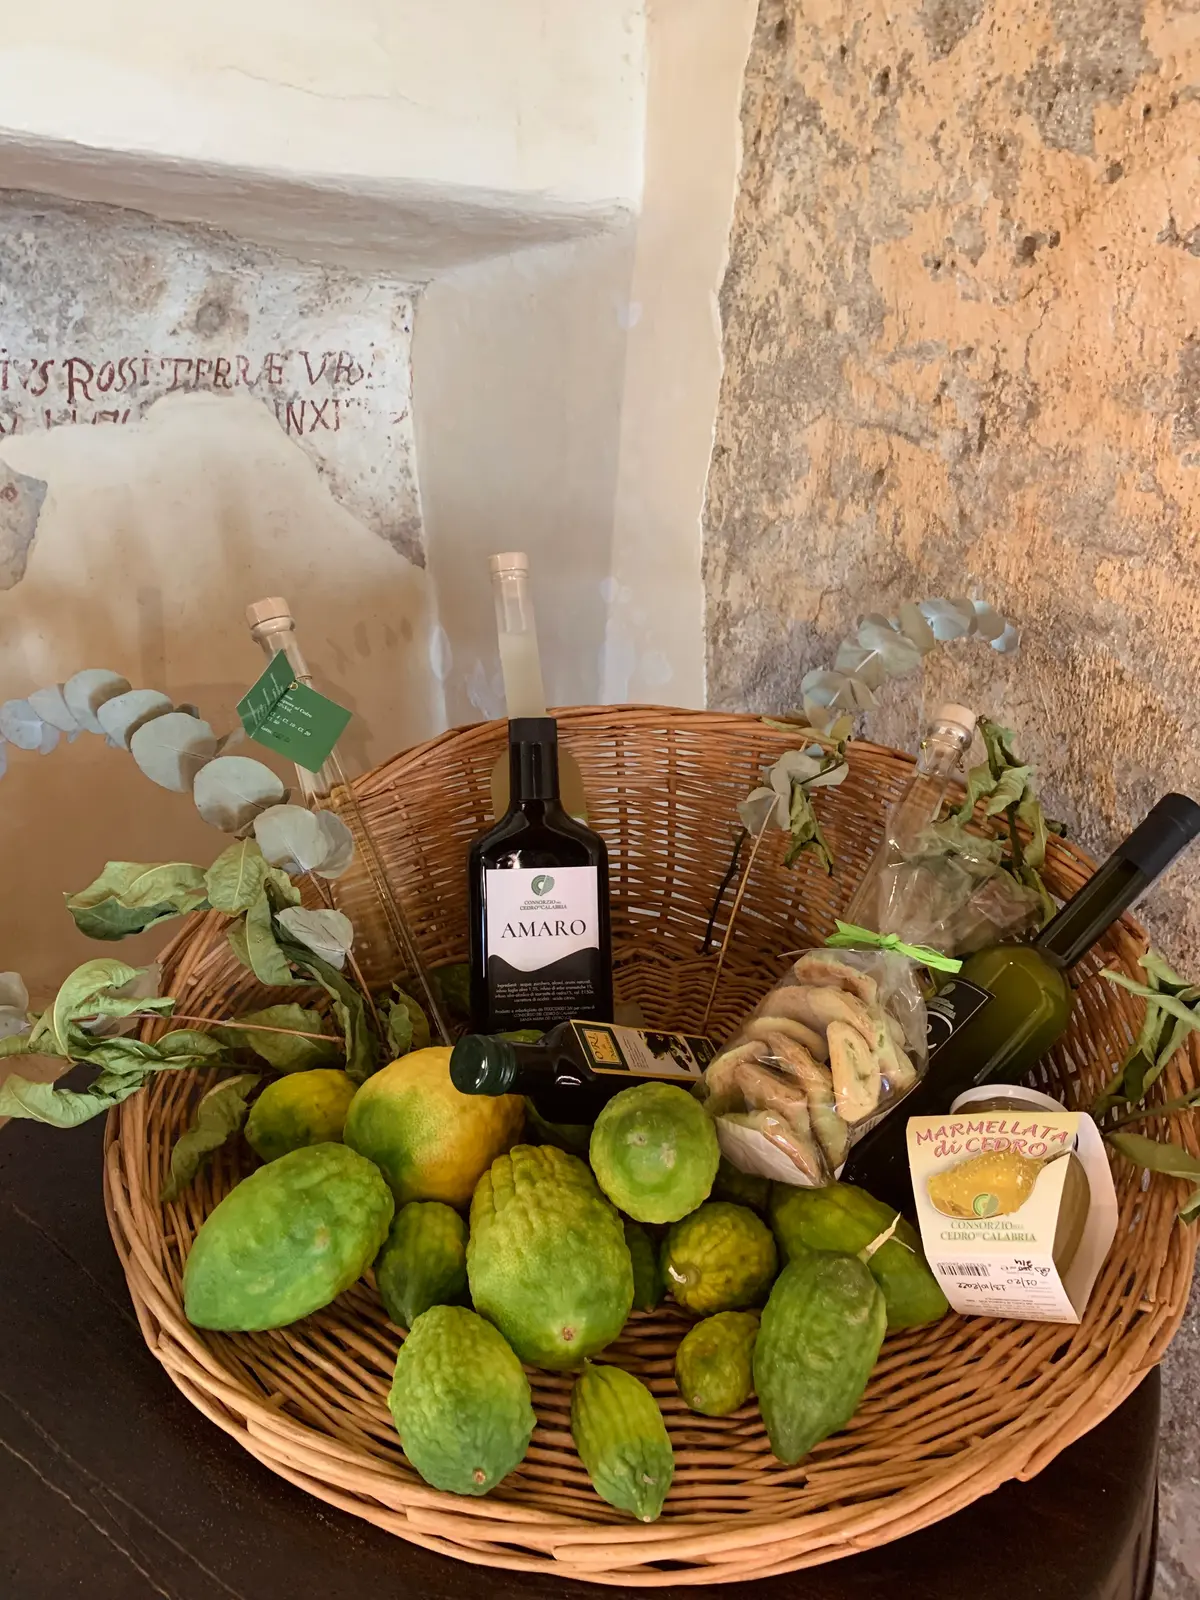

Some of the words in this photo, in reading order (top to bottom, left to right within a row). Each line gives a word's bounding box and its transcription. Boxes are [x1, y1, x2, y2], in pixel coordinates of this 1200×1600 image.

[500, 918, 587, 939] AMARO
[915, 1119, 1070, 1146] MARMELLATA
[933, 1139, 963, 1158] di
[964, 1136, 1049, 1157] CEDRO
[950, 1220, 1013, 1230] CONSORZIO
[940, 1231, 976, 1241] CEDRO
[982, 1231, 1037, 1242] CALABRIA
